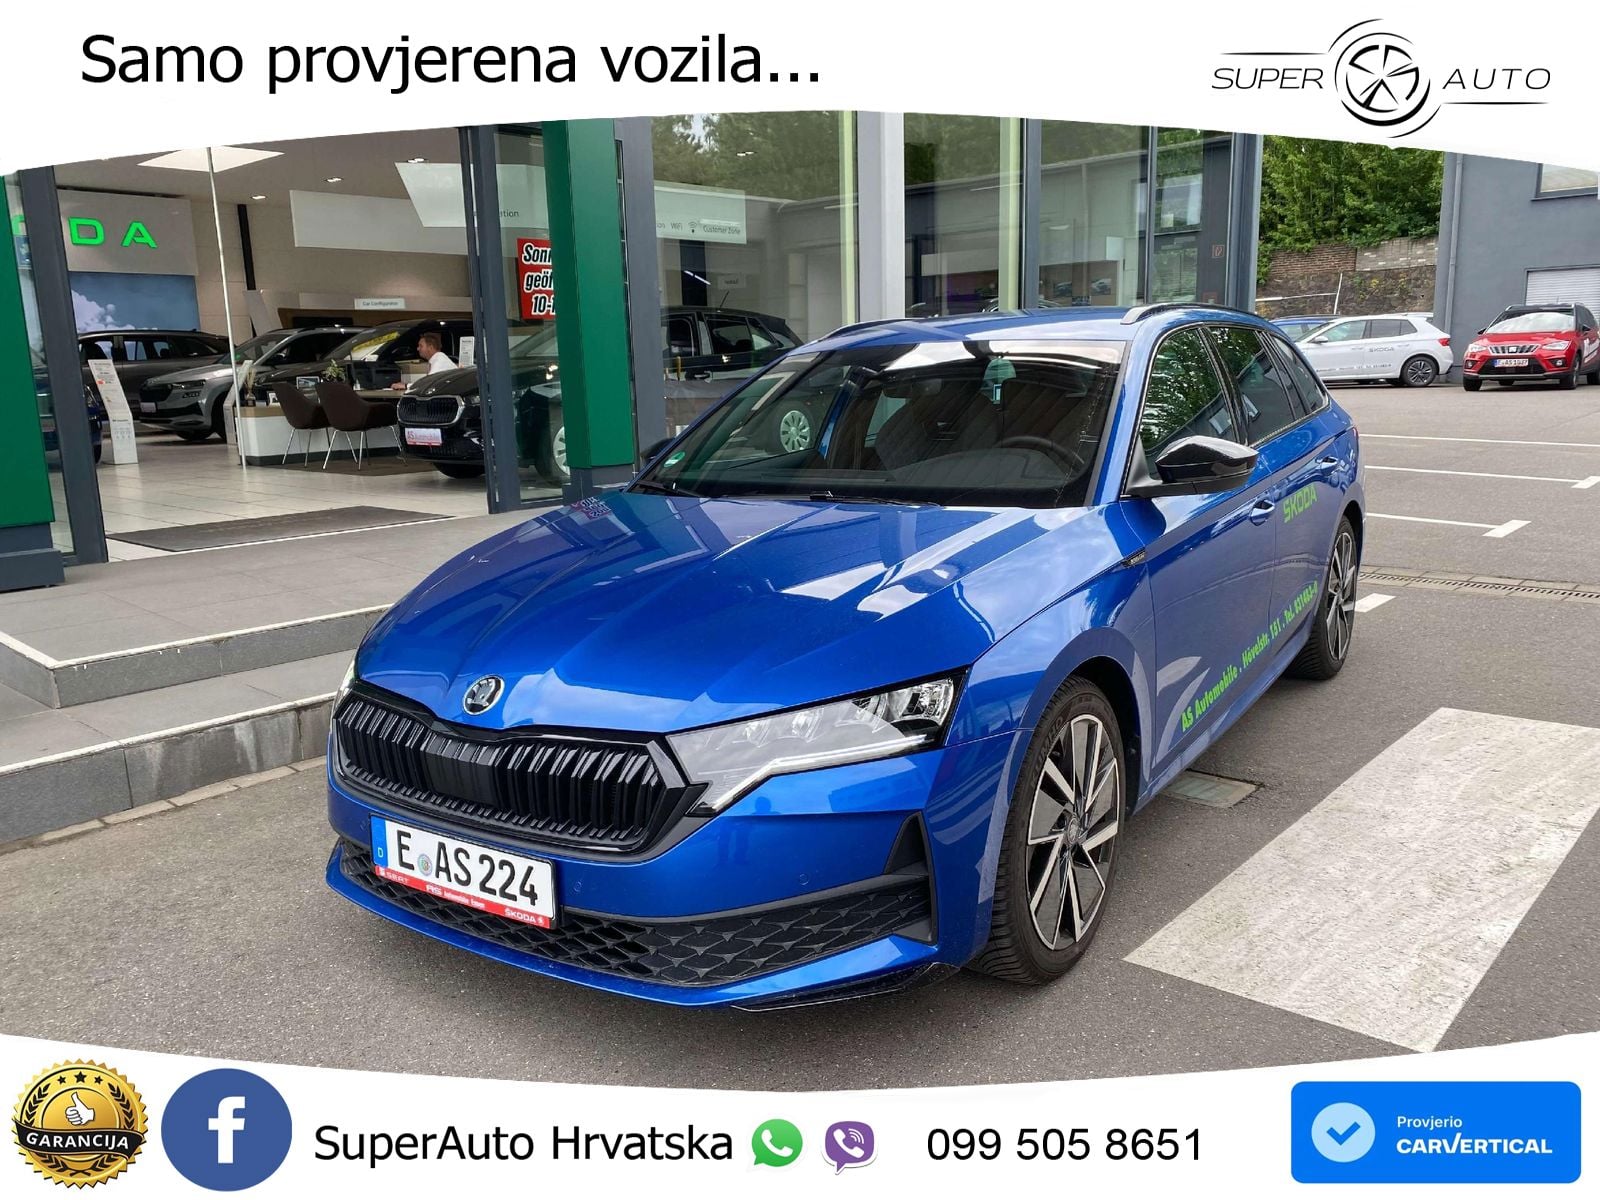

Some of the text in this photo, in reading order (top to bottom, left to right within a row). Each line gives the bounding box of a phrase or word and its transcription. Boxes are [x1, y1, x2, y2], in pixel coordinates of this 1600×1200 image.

[1181, 706, 1194, 732] AS
[1195, 664, 1238, 719] Automobile
[397, 829, 415, 871] E
